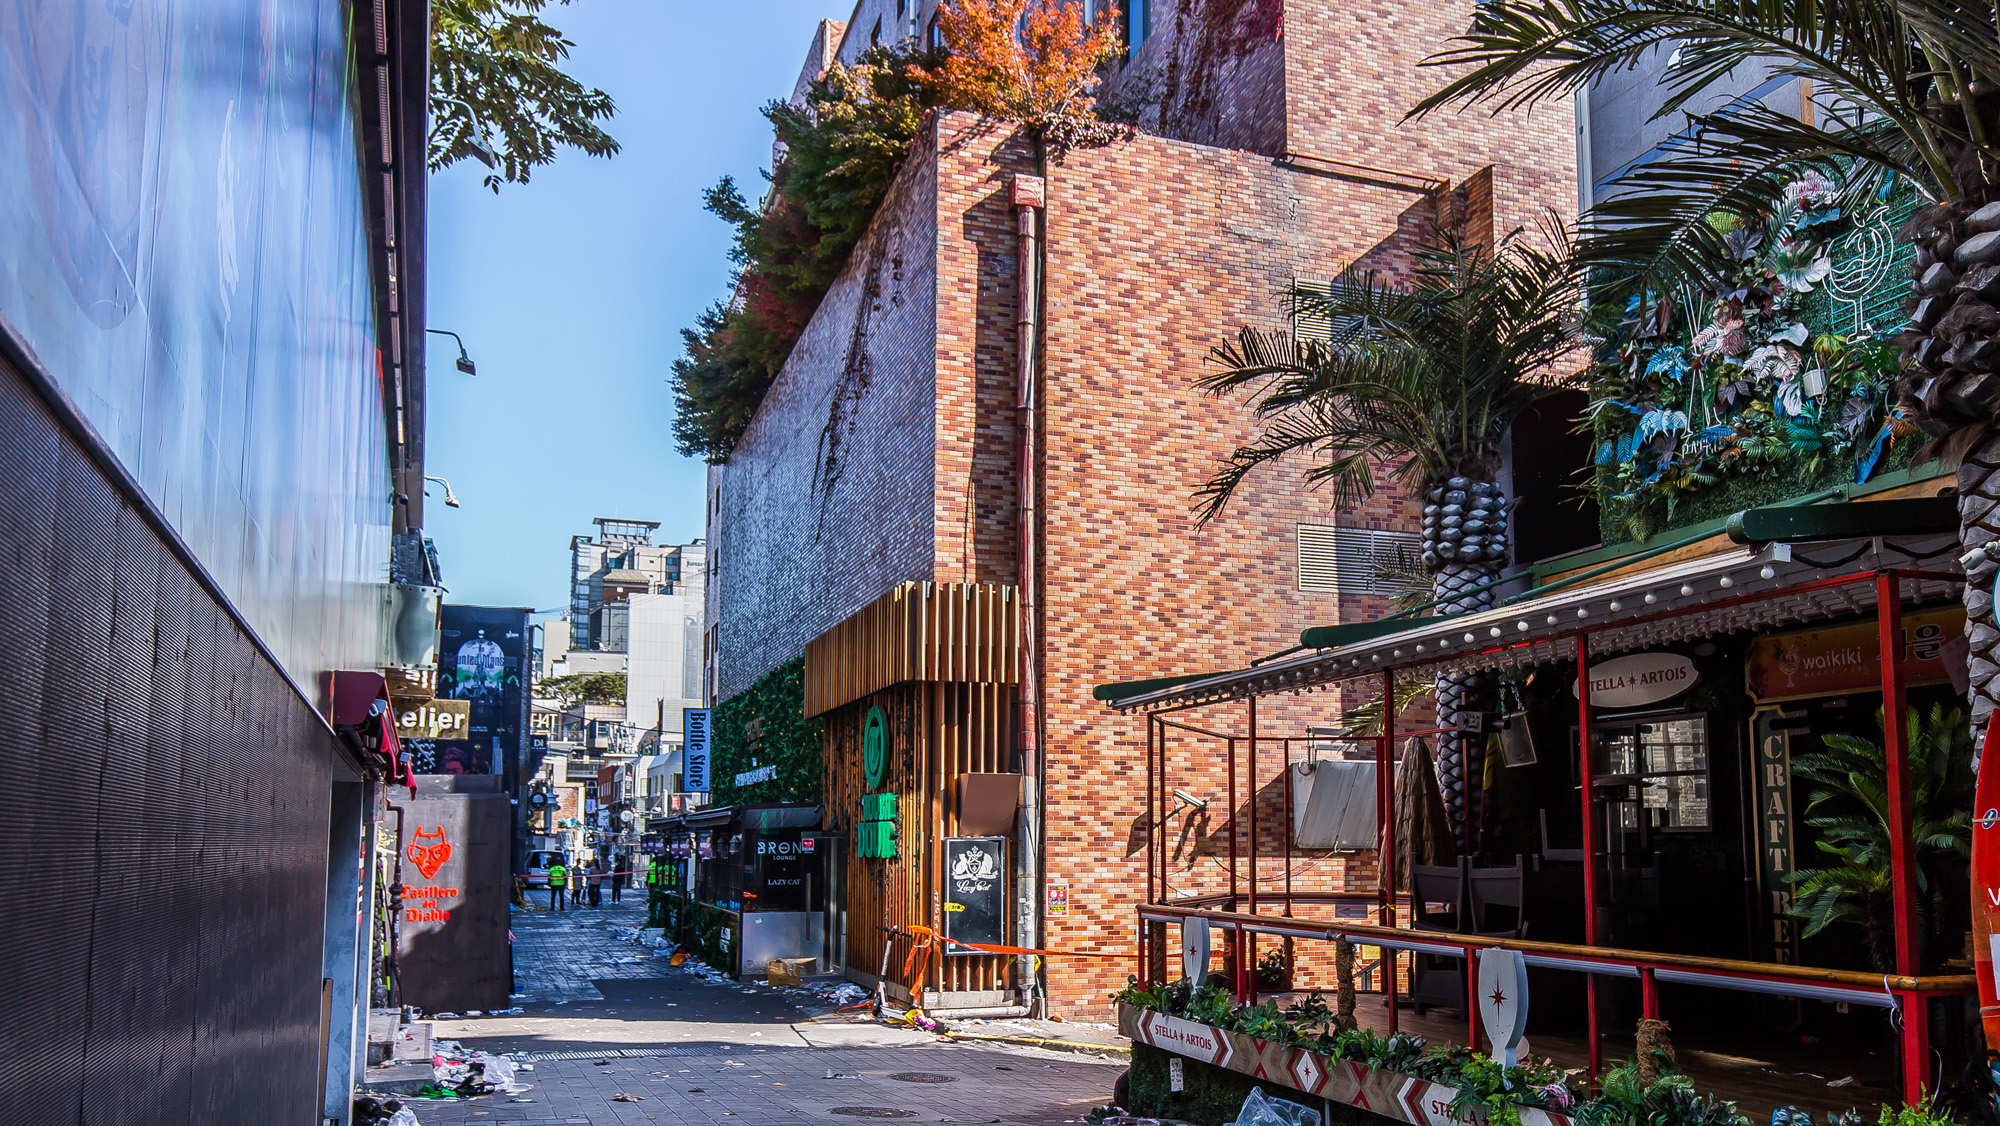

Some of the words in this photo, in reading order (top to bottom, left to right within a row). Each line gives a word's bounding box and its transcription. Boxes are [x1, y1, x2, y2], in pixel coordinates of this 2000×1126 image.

[1803, 646, 1861, 670] waikiki
[1589, 676, 1625, 692] TELLA
[1640, 666, 1687, 685] ARTOIS
[689, 712, 706, 750] Bottle
[689, 754, 706, 787] Store
[1764, 735, 1788, 871] CRAFT
[956, 880, 976, 894] Lazy
[976, 880, 992, 892] Cat
[406, 908, 451, 923] Diablo
[422, 899, 438, 909] del
[1771, 890, 1795, 1000] BEE
[1155, 1024, 1178, 1041] STELLA
[1185, 1033, 1212, 1051] ARTOIS
